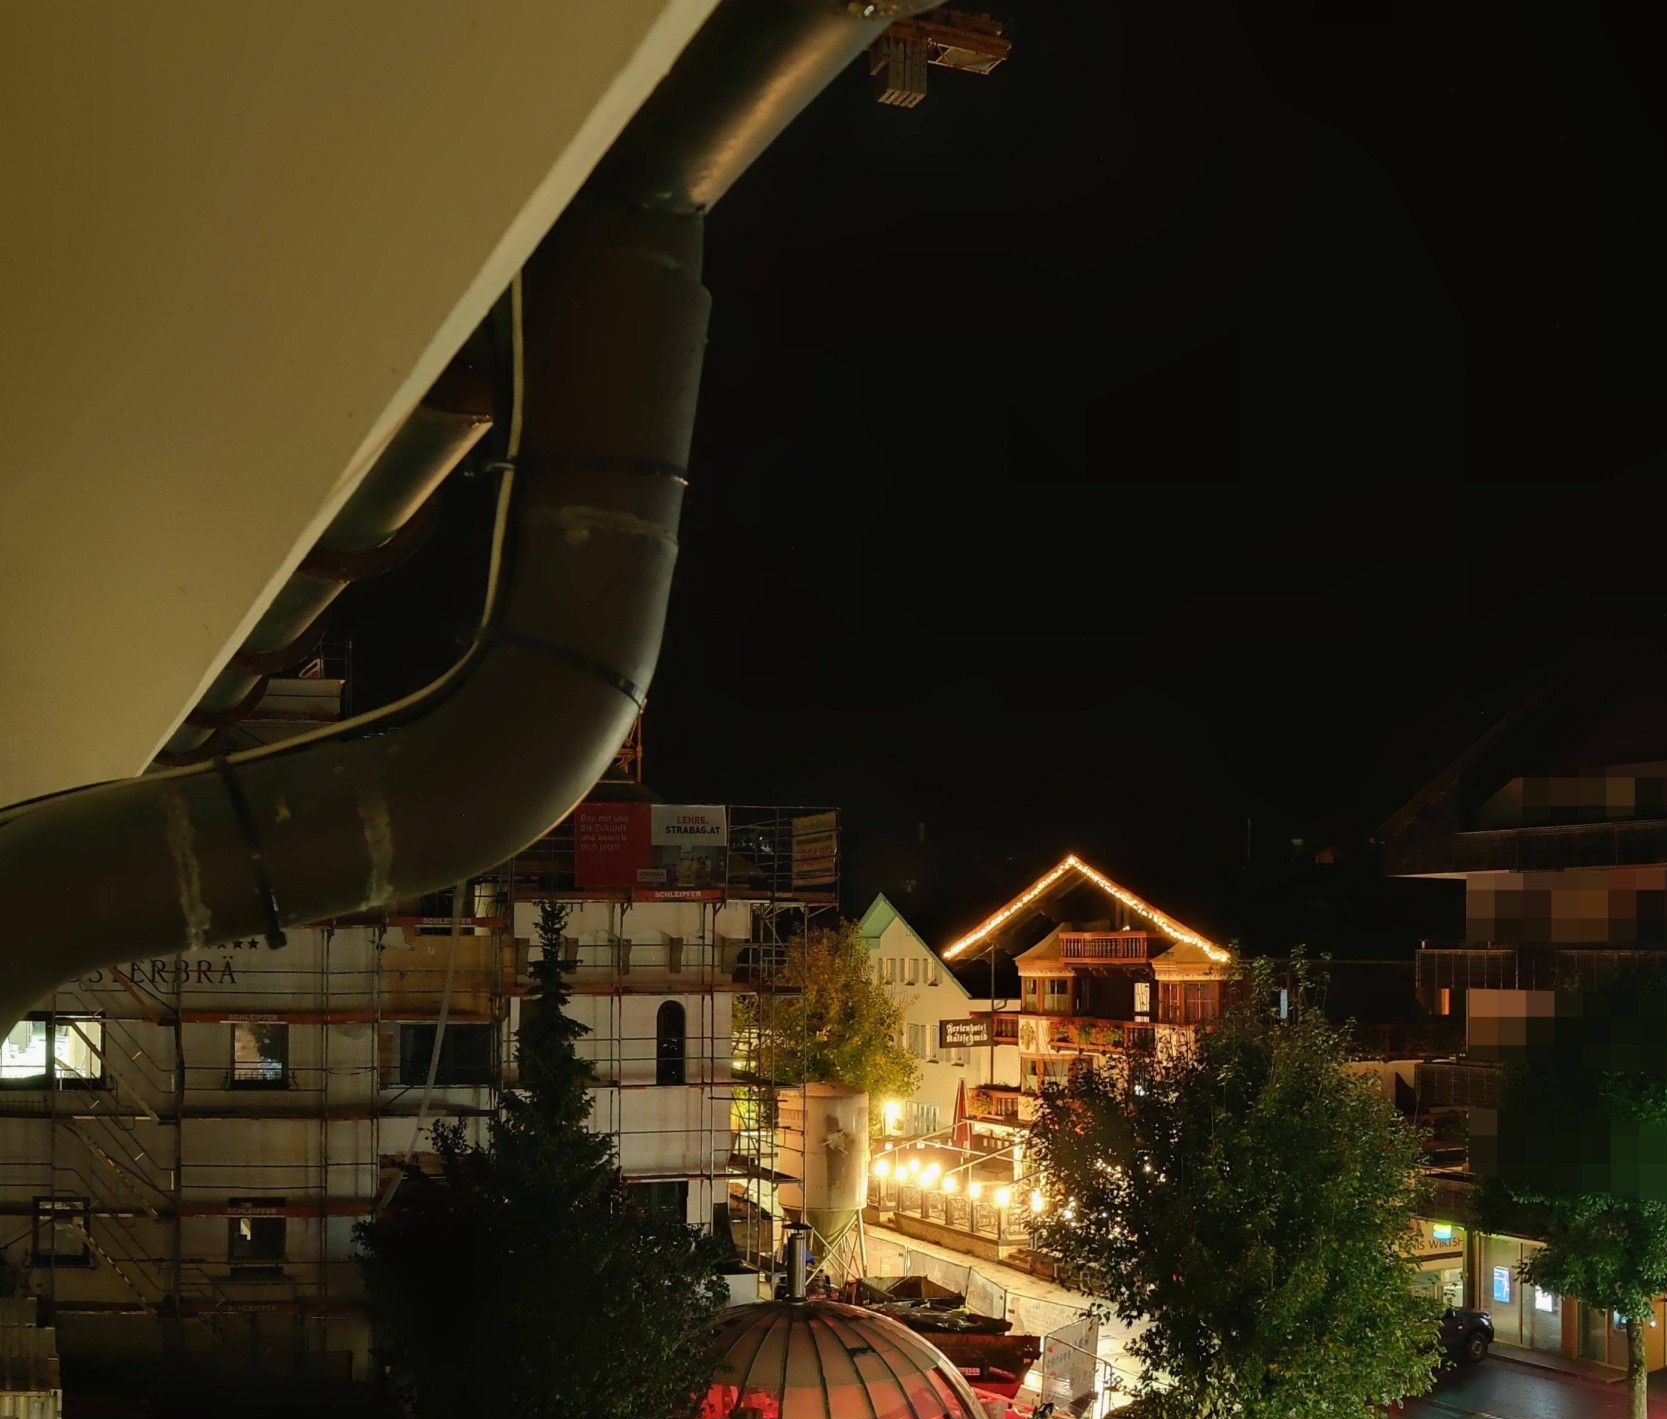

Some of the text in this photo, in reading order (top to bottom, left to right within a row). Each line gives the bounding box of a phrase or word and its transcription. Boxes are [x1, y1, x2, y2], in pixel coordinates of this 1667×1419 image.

[676, 815, 709, 825] LEHRE.
[595, 824, 627, 832] Zukunft
[665, 825, 721, 835] STRABAG.AT
[228, 1014, 279, 1022] SCHLEIPFER
